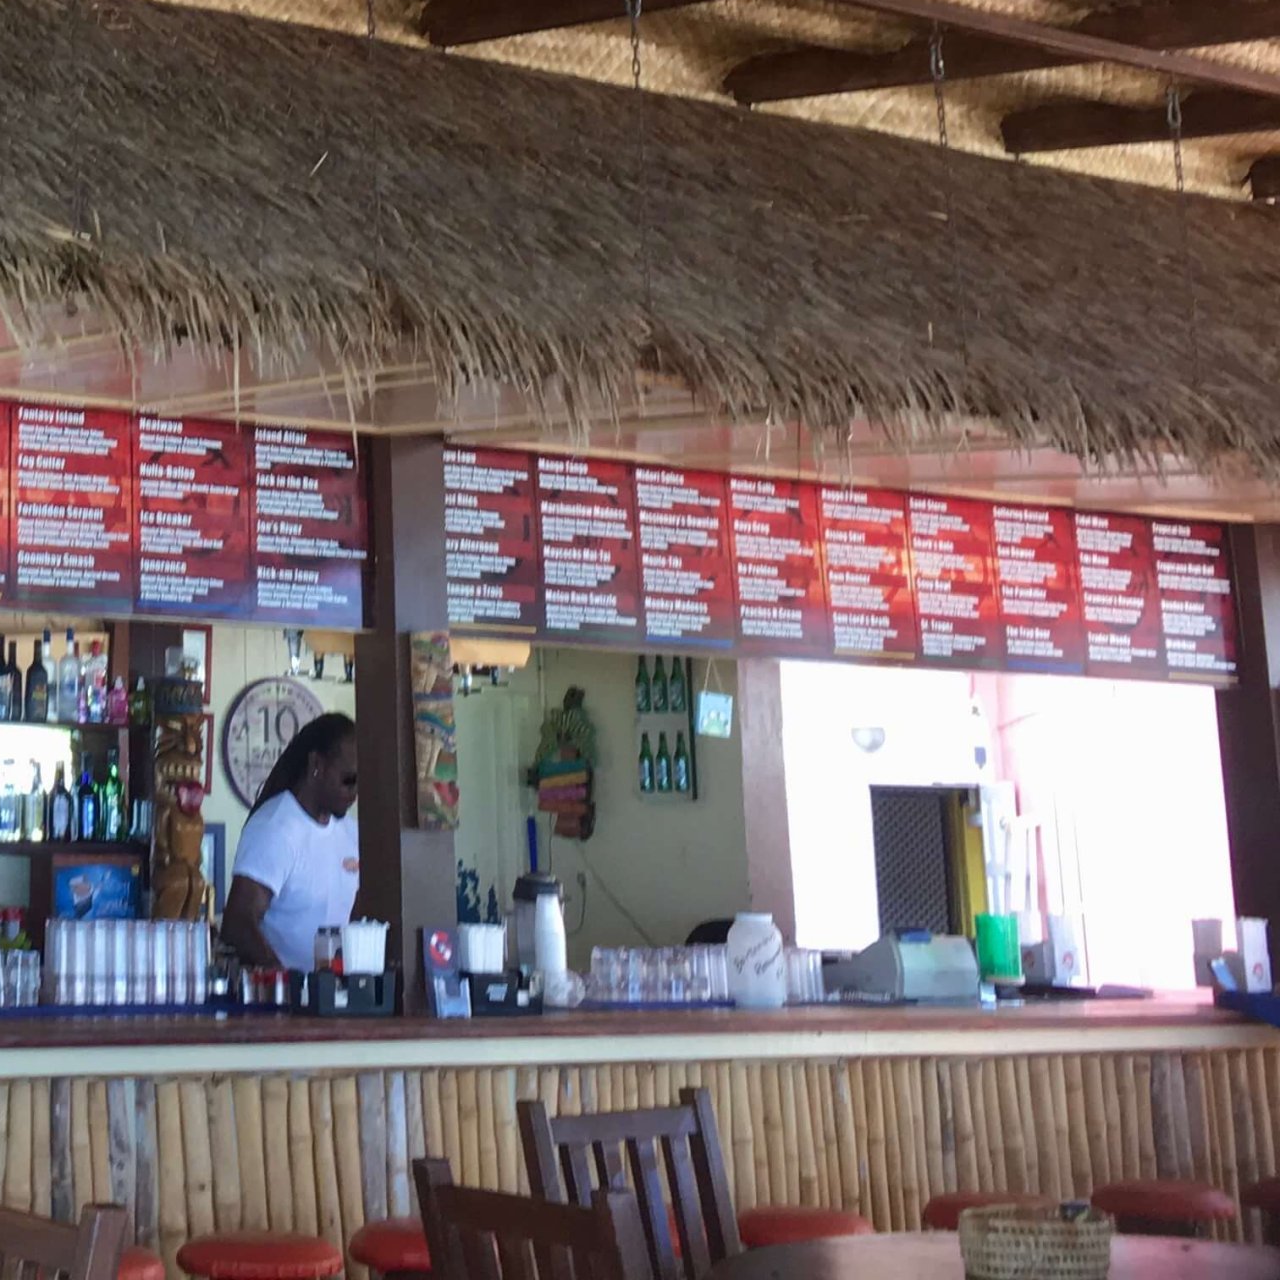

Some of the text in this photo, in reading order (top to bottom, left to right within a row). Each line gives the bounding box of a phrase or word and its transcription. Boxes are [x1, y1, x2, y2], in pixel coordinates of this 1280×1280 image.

[18, 406, 85, 426] Fantasy Island
[255, 427, 282, 443] Island
